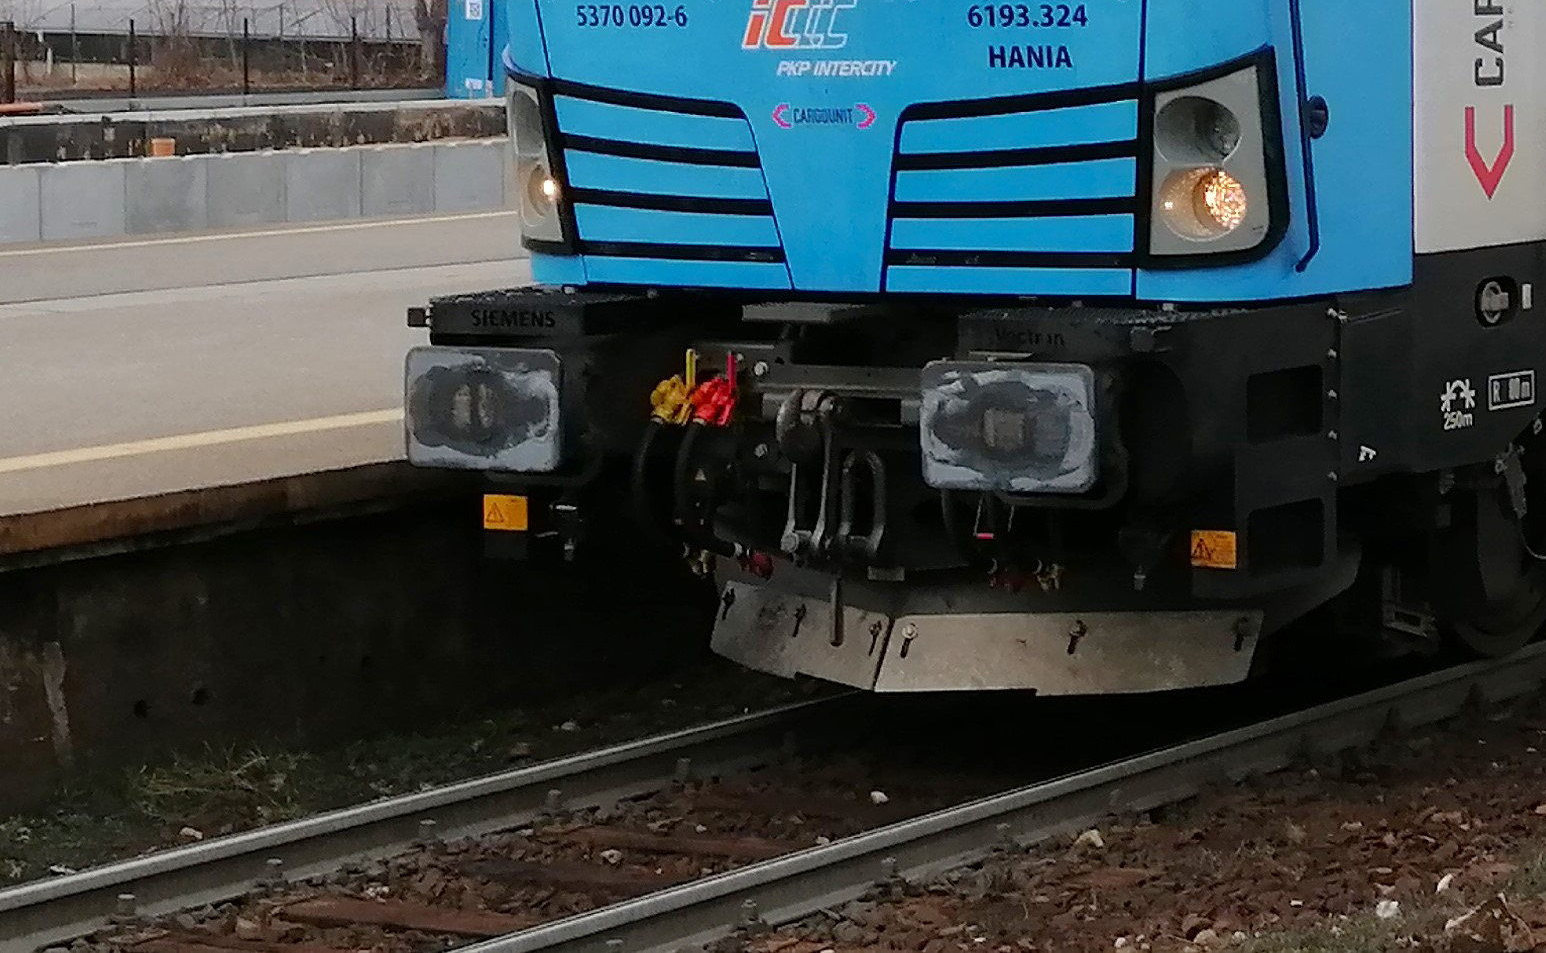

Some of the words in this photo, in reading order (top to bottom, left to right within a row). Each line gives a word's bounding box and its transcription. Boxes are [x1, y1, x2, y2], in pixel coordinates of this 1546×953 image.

[576, 4, 624, 27] 5370
[629, 4, 688, 27] 092-6
[967, 4, 1088, 28] 6193.324
[988, 45, 1073, 68] HANIA
[776, 60, 811, 77] PKP
[813, 60, 898, 77] INTERCITY
[793, 107, 854, 124] CARGOUNIT
[470, 309, 556, 328] SIEMENS
